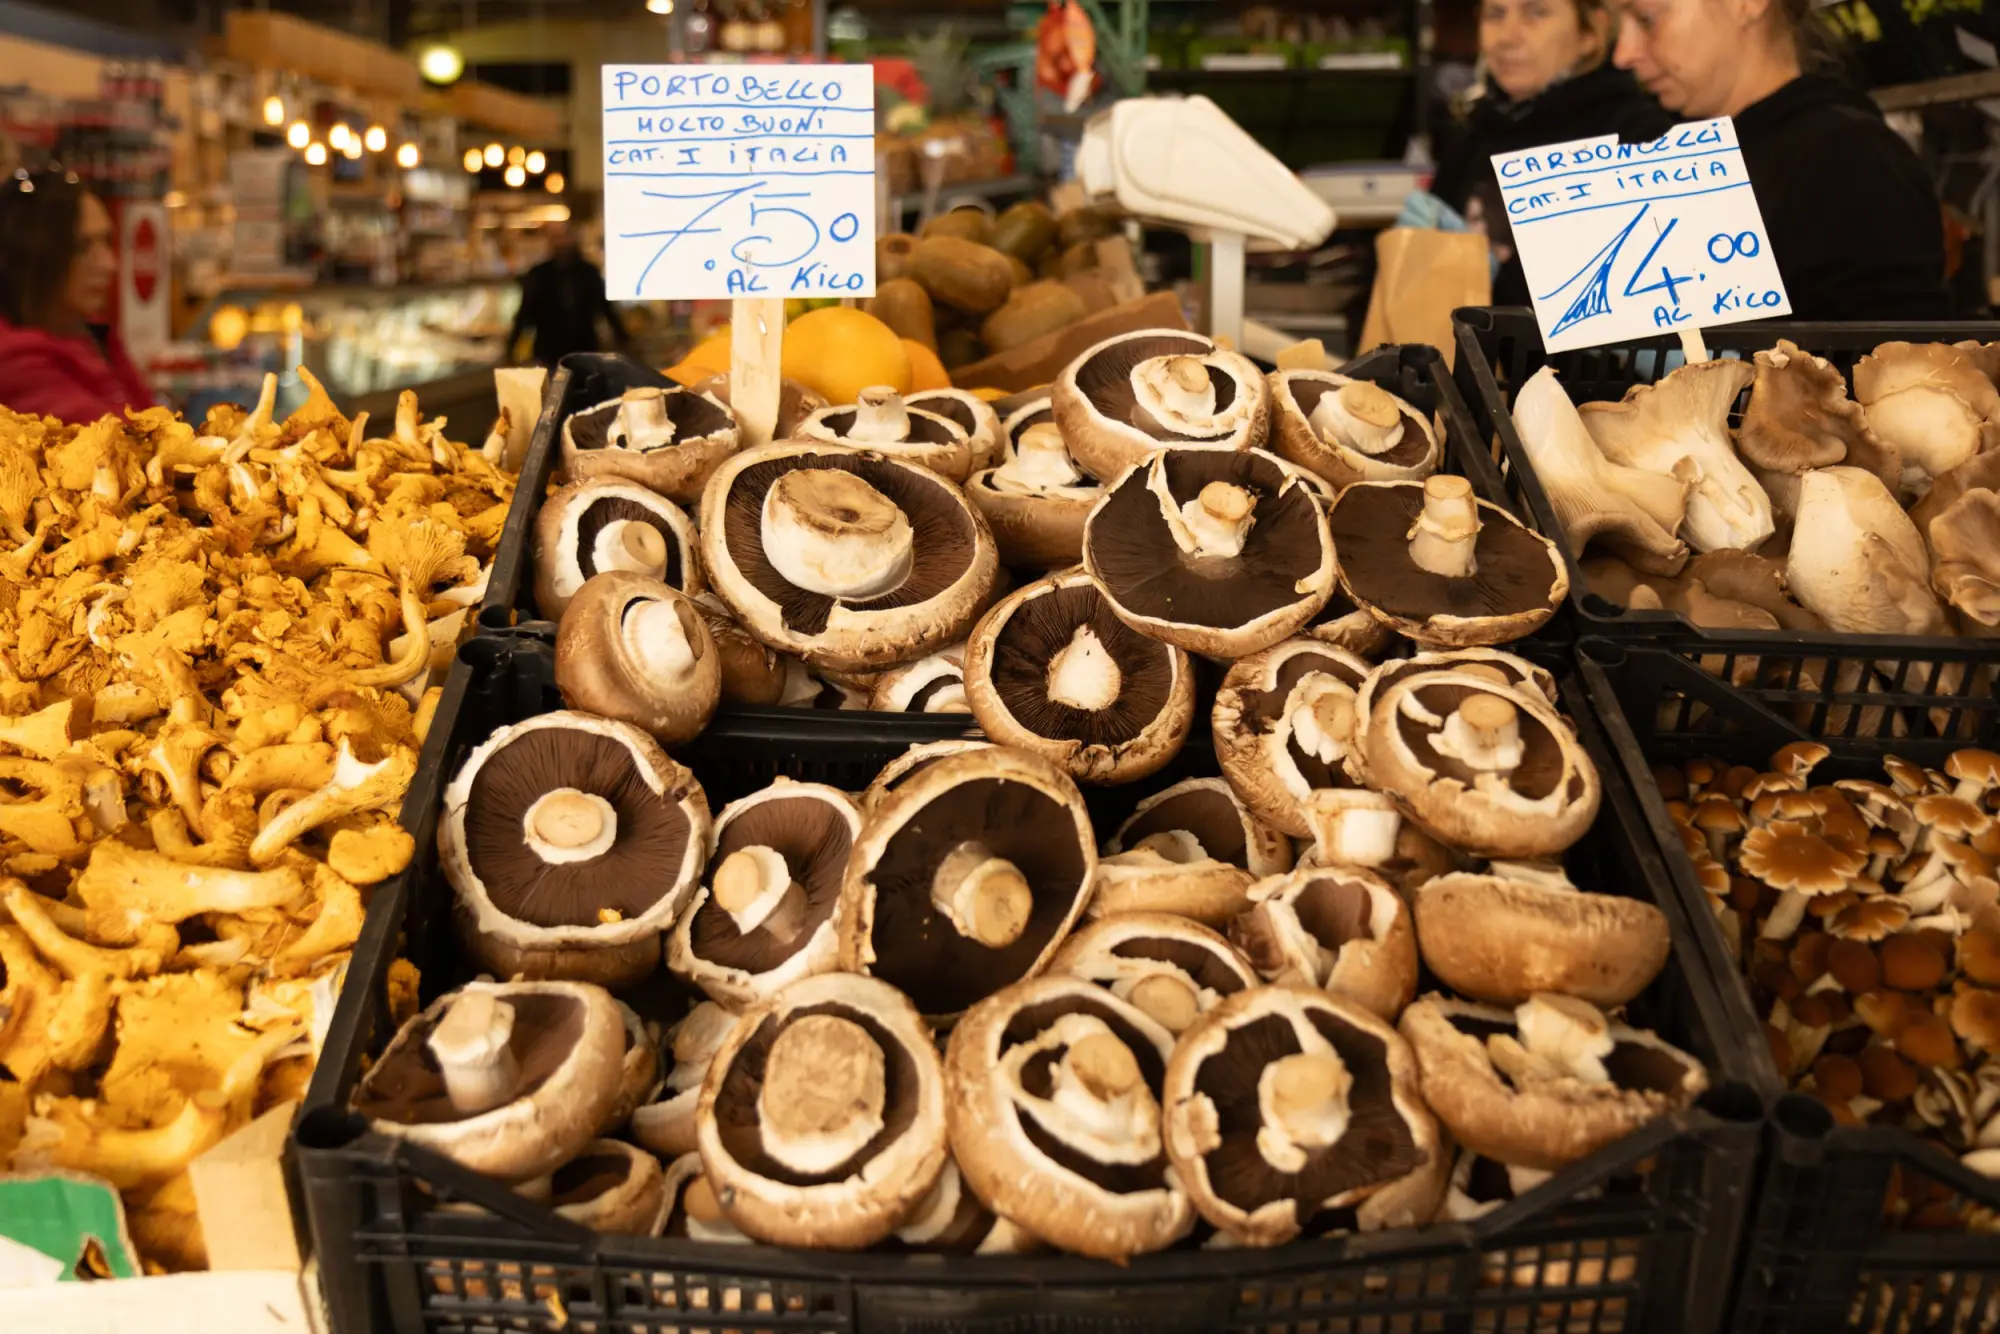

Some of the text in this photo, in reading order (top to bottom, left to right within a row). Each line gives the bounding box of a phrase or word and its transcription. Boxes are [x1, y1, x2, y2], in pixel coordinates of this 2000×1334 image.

[638, 116, 725, 133] MOLTO
[608, 147, 665, 165] CAT.
[677, 147, 701, 165] I
[1508, 191, 1561, 215] CAT.
[1565, 182, 1592, 201] I
[727, 268, 769, 294] AL
[1653, 306, 1693, 328] AL
